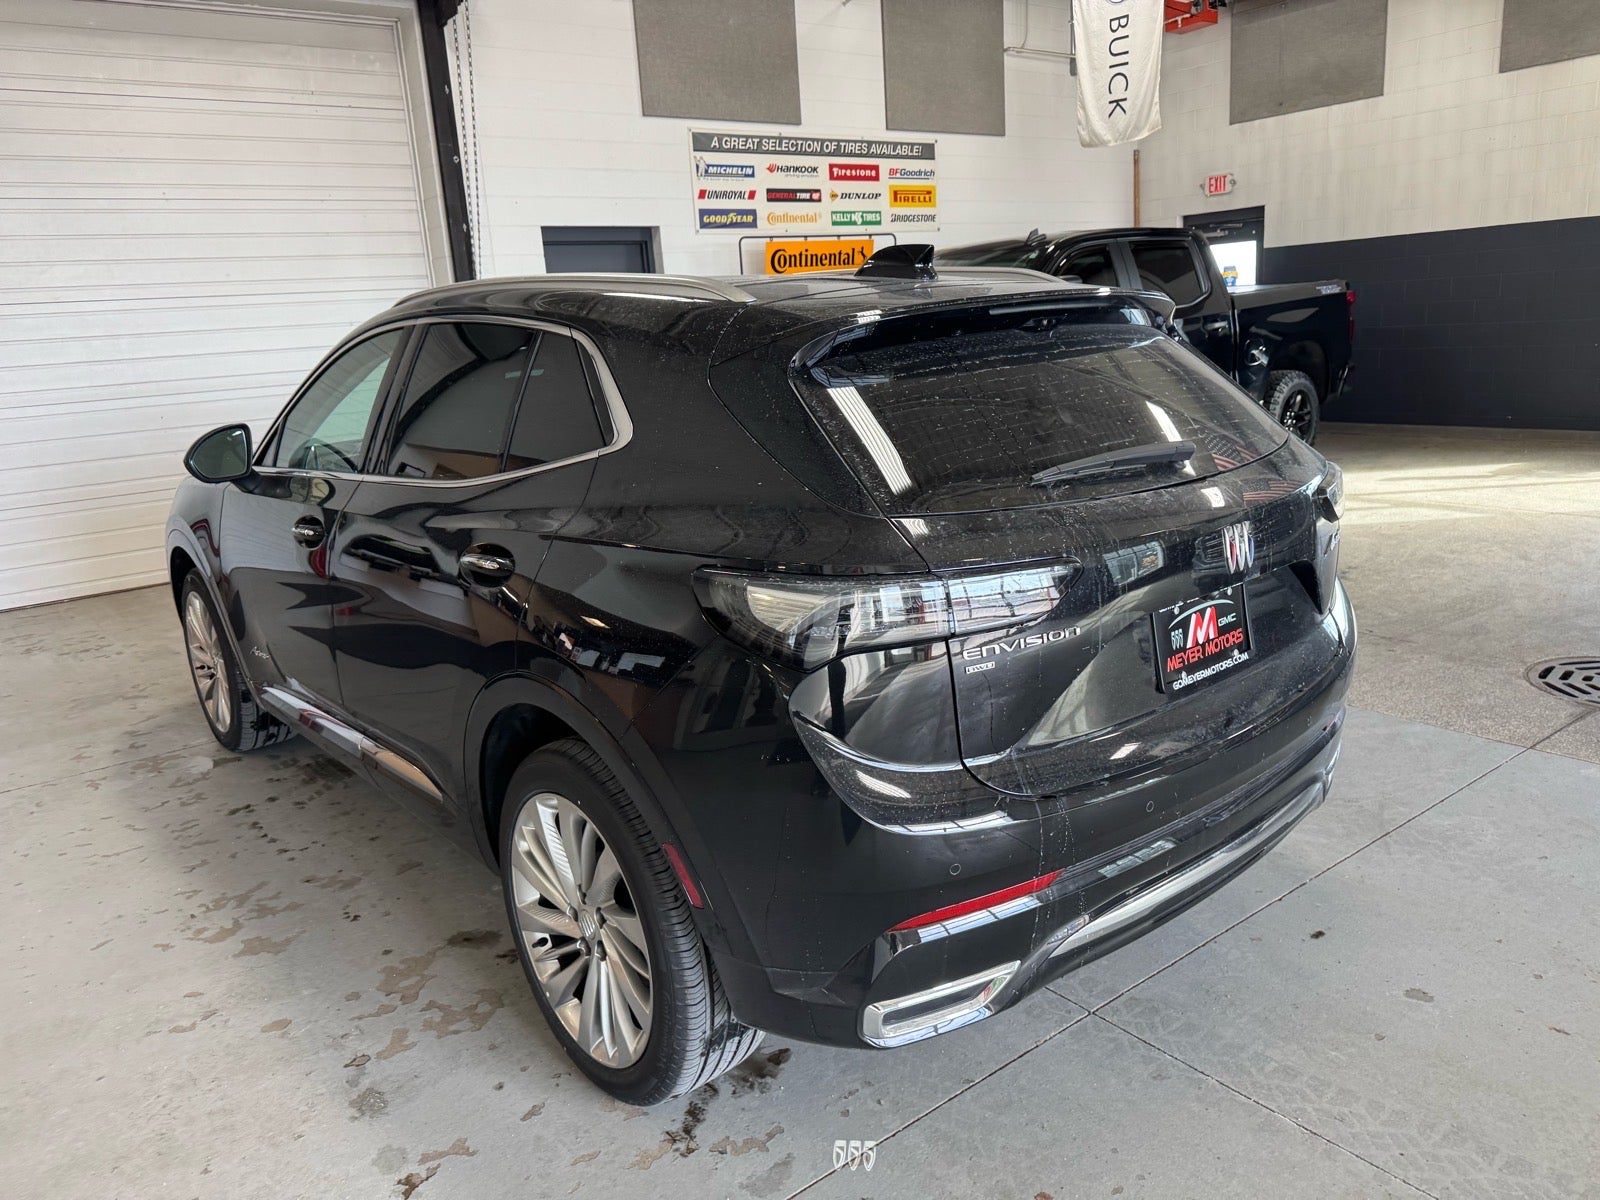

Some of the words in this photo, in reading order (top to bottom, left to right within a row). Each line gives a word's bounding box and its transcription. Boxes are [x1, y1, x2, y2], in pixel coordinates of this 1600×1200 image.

[1108, 14, 1129, 119] BUICK
[711, 136, 719, 149] A
[722, 137, 759, 150] GREAT
[762, 139, 820, 152] SELECTION
[823, 141, 837, 153] OF
[840, 142, 868, 154] TIRES
[870, 143, 922, 156] AVAILABLE!
[708, 166, 753, 175] MICHELIN
[832, 167, 876, 178] Firestone
[889, 168, 935, 177] BFGoodrich
[1209, 175, 1227, 193] EXIT
[707, 189, 747, 200] UNIROYAL
[840, 192, 881, 200] DUNLOP
[893, 190, 932, 203] PIRELLI
[767, 211, 817, 225] Continental
[832, 213, 852, 222] KELLY
[863, 213, 880, 221] TIRES
[891, 213, 936, 223] BRIDGESTONE
[771, 247, 855, 274] Continental
[1218, 612, 1237, 627] GMC
[1167, 645, 1203, 673] MEYER
[1205, 628, 1244, 657] MOTORS
[1172, 652, 1249, 690] GOMEYERMOTORS.COM
